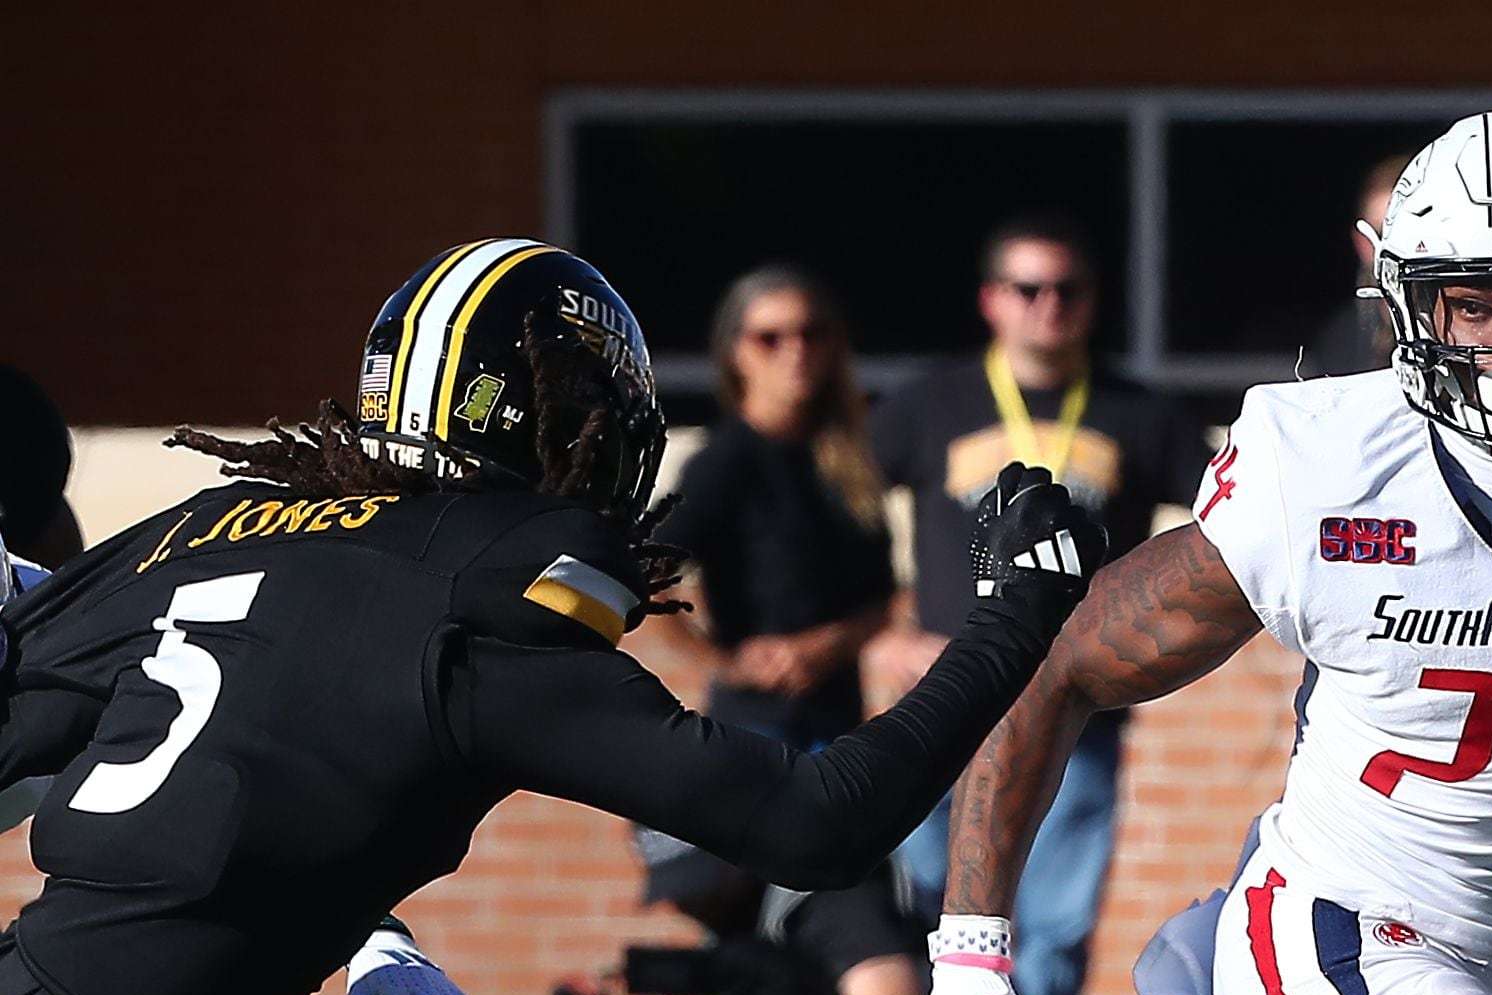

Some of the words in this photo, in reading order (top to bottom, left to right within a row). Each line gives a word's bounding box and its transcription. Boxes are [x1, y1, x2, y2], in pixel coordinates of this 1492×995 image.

[410, 412, 421, 431] 5
[502, 405, 524, 423] MJ
[386, 441, 425, 469] THE
[188, 495, 400, 548] JONES
[1320, 517, 1417, 566] SBC
[67, 571, 266, 815] 5
